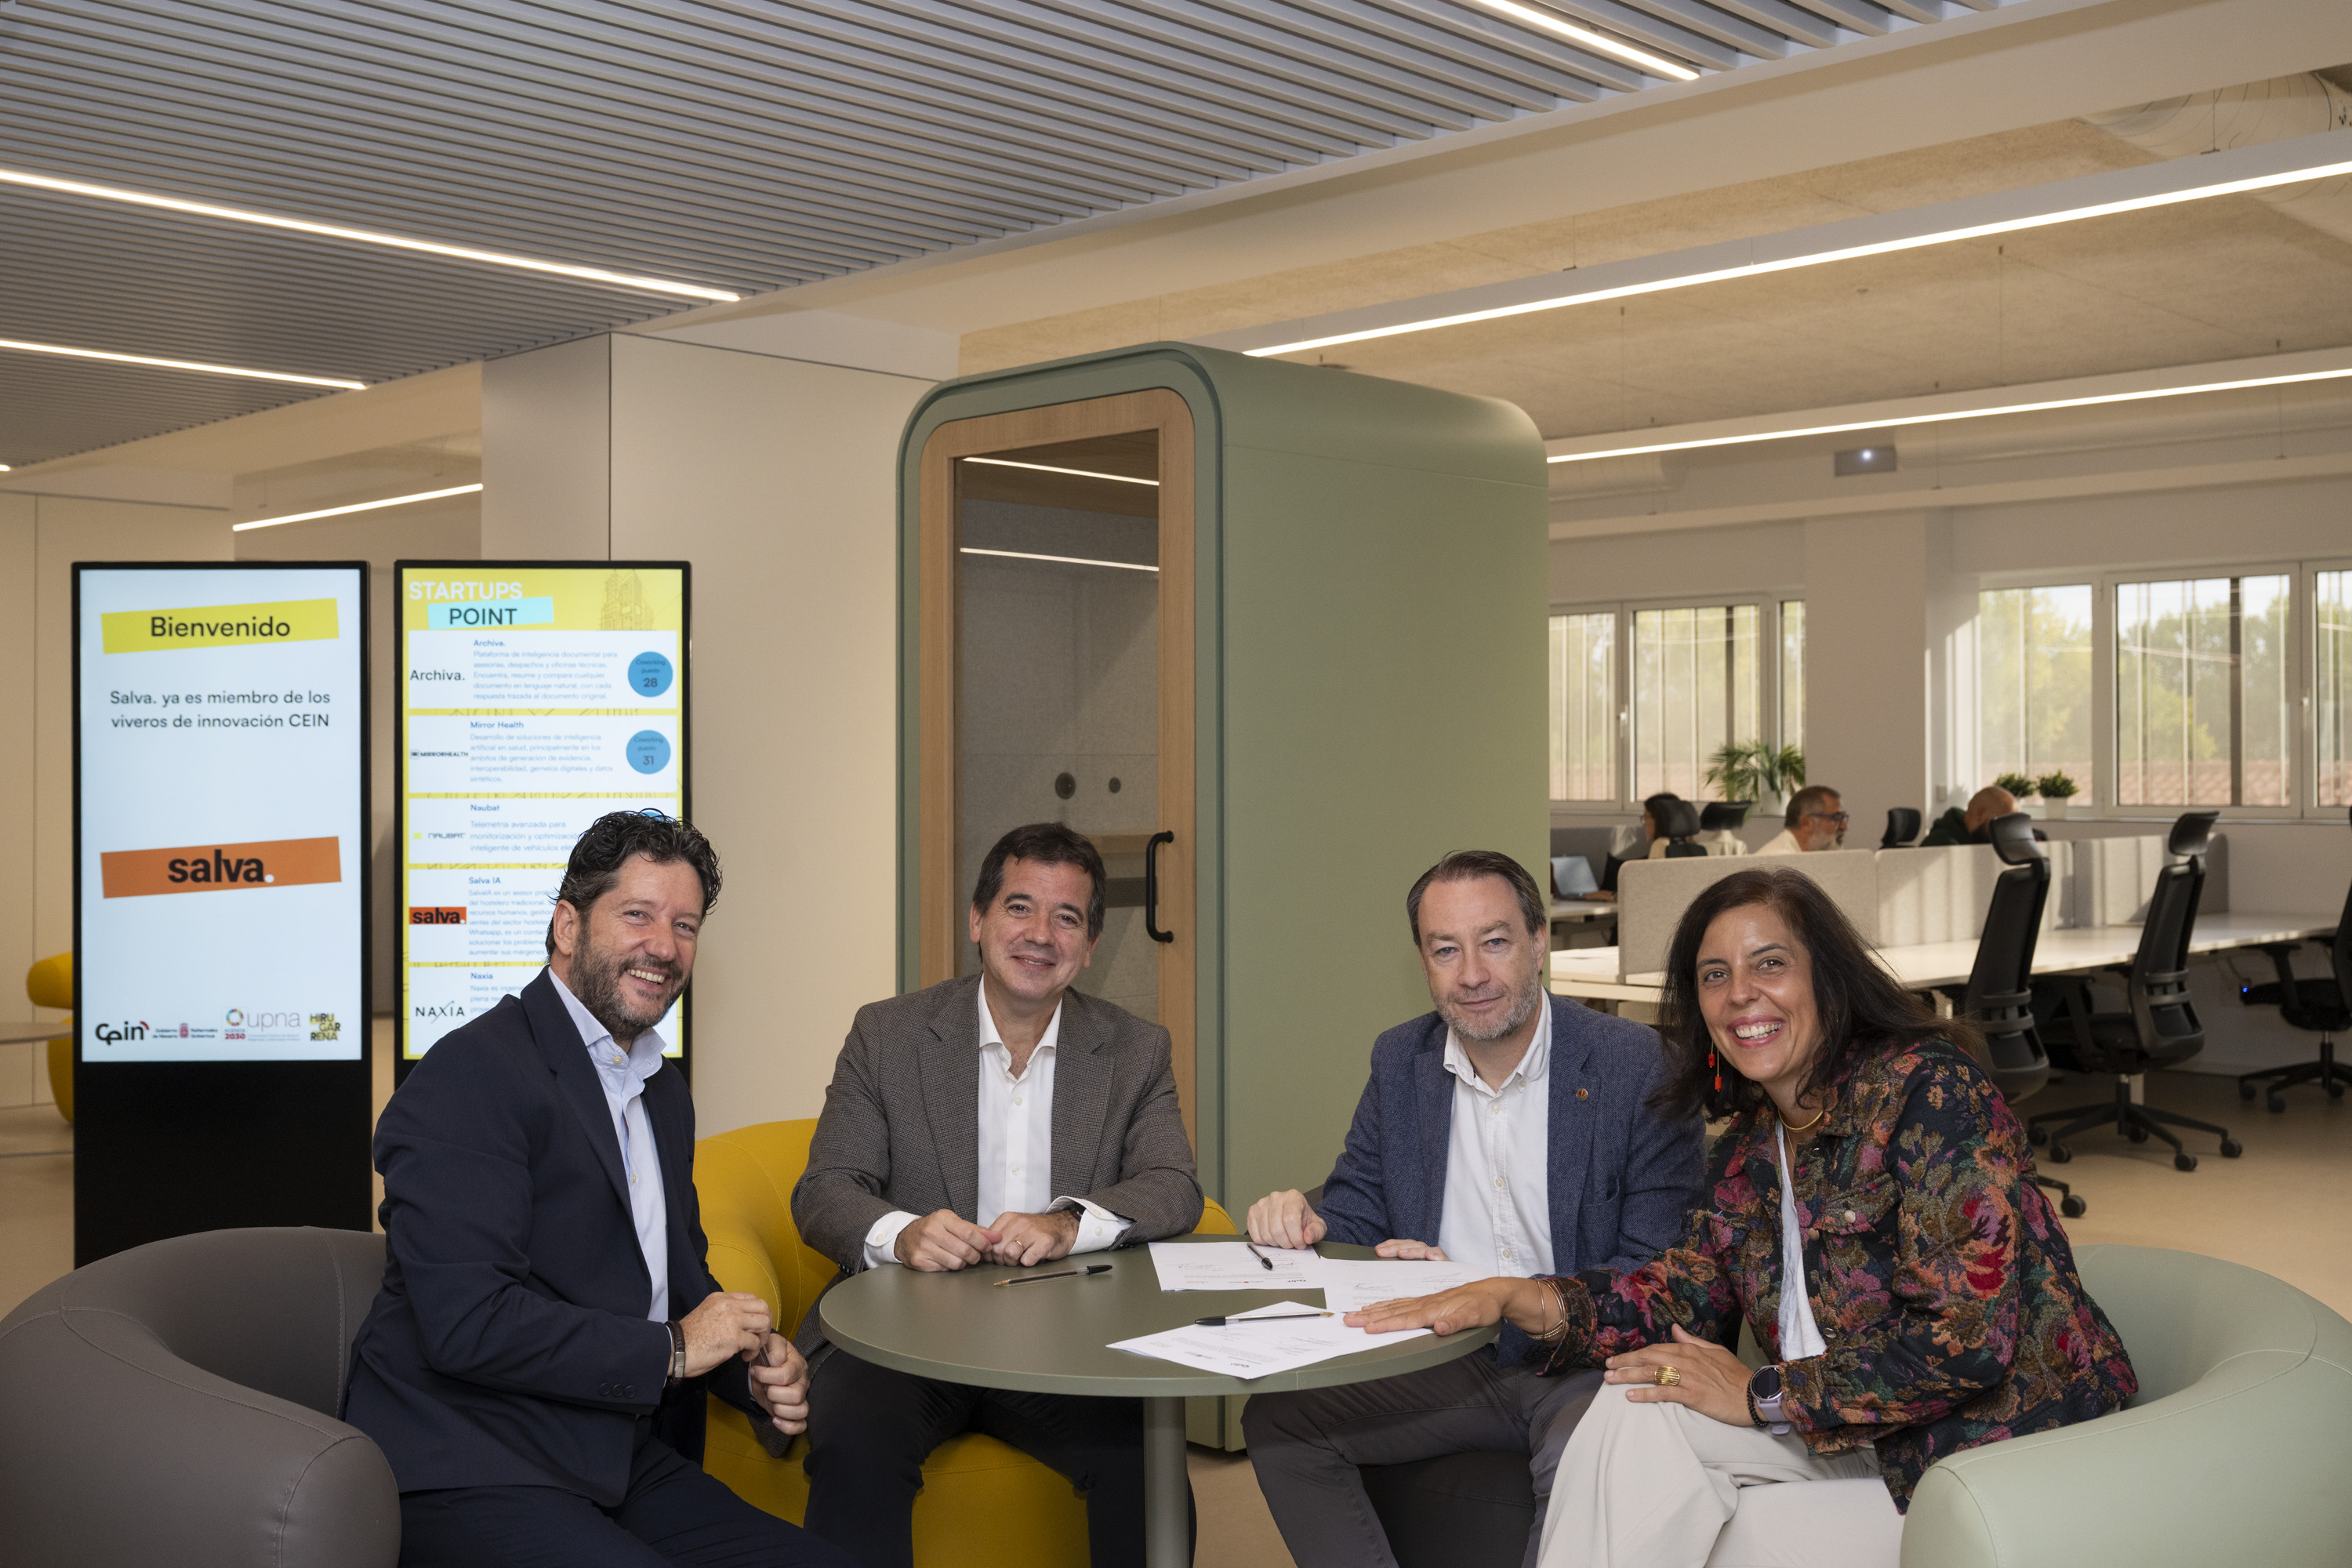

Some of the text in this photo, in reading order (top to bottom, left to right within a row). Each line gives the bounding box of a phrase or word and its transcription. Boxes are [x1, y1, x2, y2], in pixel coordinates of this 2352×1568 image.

[408, 581, 523, 600] STARTUPS
[449, 608, 517, 625] POINT
[151, 615, 291, 637] Bienvenido
[521, 651, 559, 659] inteligencia
[410, 670, 466, 681] Archiva.
[644, 677, 658, 688] 28
[110, 690, 330, 708] Salva. ya es miembro de los
[111, 713, 329, 728] viveros de innovación CEIN
[564, 733, 601, 742] inteligencia
[643, 755, 655, 765] 31
[534, 832, 578, 841] optimizació
[470, 844, 510, 853] inteligente
[167, 848, 274, 884] salva.
[412, 907, 466, 924] salva.
[247, 1012, 301, 1032] upna
